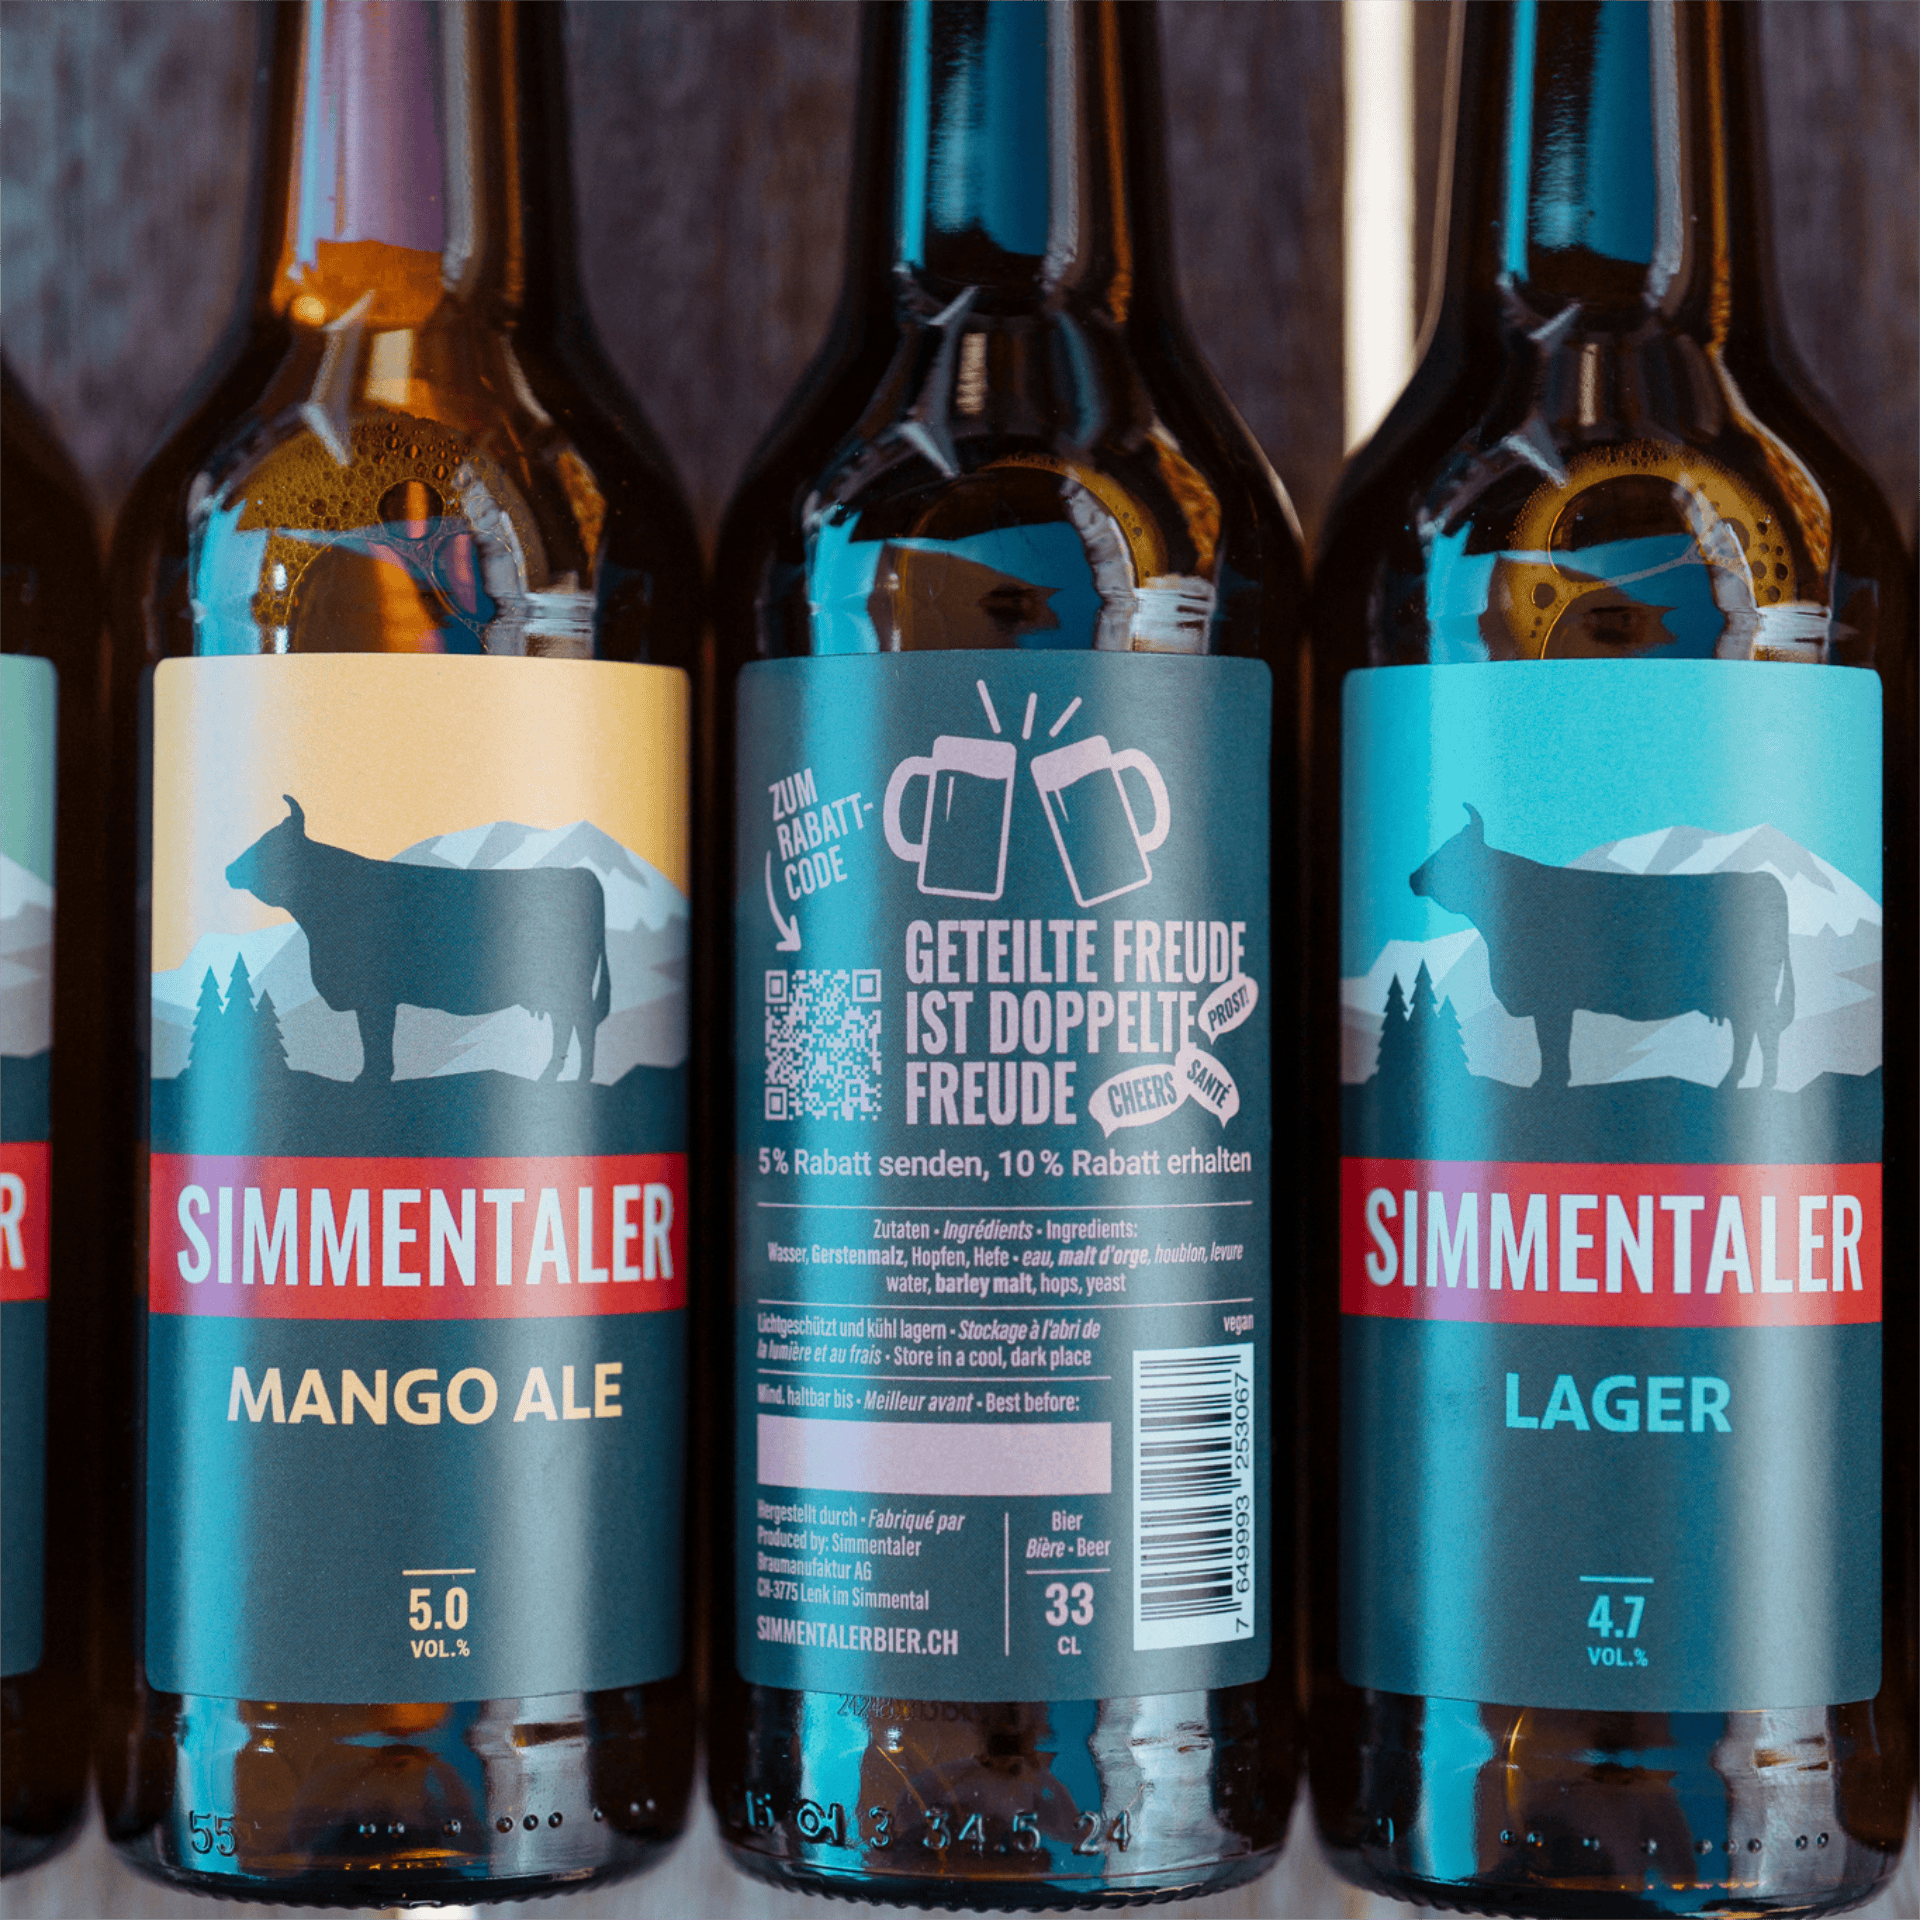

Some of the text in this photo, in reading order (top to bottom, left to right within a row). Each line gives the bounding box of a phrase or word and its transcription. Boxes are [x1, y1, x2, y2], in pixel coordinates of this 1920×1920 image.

[768, 767, 818, 821] ZUM
[776, 792, 873, 861] RABATT-
[785, 845, 848, 900] CODE
[906, 919, 1246, 983] GETEILTE FREUDE
[906, 990, 1197, 1054] IST DOPPELTE
[1208, 984, 1250, 1032] PROST!
[906, 1061, 1077, 1125] FREUDE
[1108, 1071, 1177, 1118] CHEERS
[1187, 1059, 1232, 1109] SANTÉ
[794, 1148, 872, 1176] Rabatt
[879, 1149, 990, 1182] senden,
[1072, 1148, 1161, 1176] Rabatt
[1167, 1146, 1252, 1174] erhalten
[177, 1183, 674, 1287] SIMMENTALER
[873, 1218, 1138, 1244] Zutaten Ingrédients Ingredients:
[1364, 1187, 1863, 1294] SIMMENTALER
[767, 1241, 1244, 1271] Wasser, Gerstenmalz, Hopfen, Hefe eau, malt d'orge, houblon, levure
[886, 1273, 1126, 1298] water, barley malt, hops, yeast
[757, 1312, 1101, 1345] Lichtgeschützt und kühl lagern Stockage à l'abri de
[1223, 1314, 1254, 1336] vegan
[757, 1338, 1092, 1371] la lumière et au frais Store in a cool, dark place
[227, 1362, 623, 1427] MANGO ALE
[757, 1383, 1080, 1413] Mind. haltbar bis Meilleur avant Best before:
[1506, 1372, 1731, 1432] LAGER
[757, 1499, 966, 1535] Hergestellt durch Fabriqué par
[1051, 1510, 1083, 1532] Bier
[1235, 1372, 1250, 1633] 7 649993 253067
[757, 1525, 922, 1557] Produced by: Simmentaler
[1026, 1536, 1111, 1559] Bière Beer
[757, 1551, 873, 1581] Braumanufaktur AG
[408, 1586, 469, 1631] 5.0
[757, 1577, 930, 1611] CH-3775 Lenk im Simmental
[1045, 1581, 1094, 1626] 33
[1588, 1594, 1645, 1638] 4.7
[757, 1615, 959, 1655] SIMMENTALERBIER.CH
[1057, 1635, 1082, 1655] CL
[187, 1809, 237, 1857] 55
